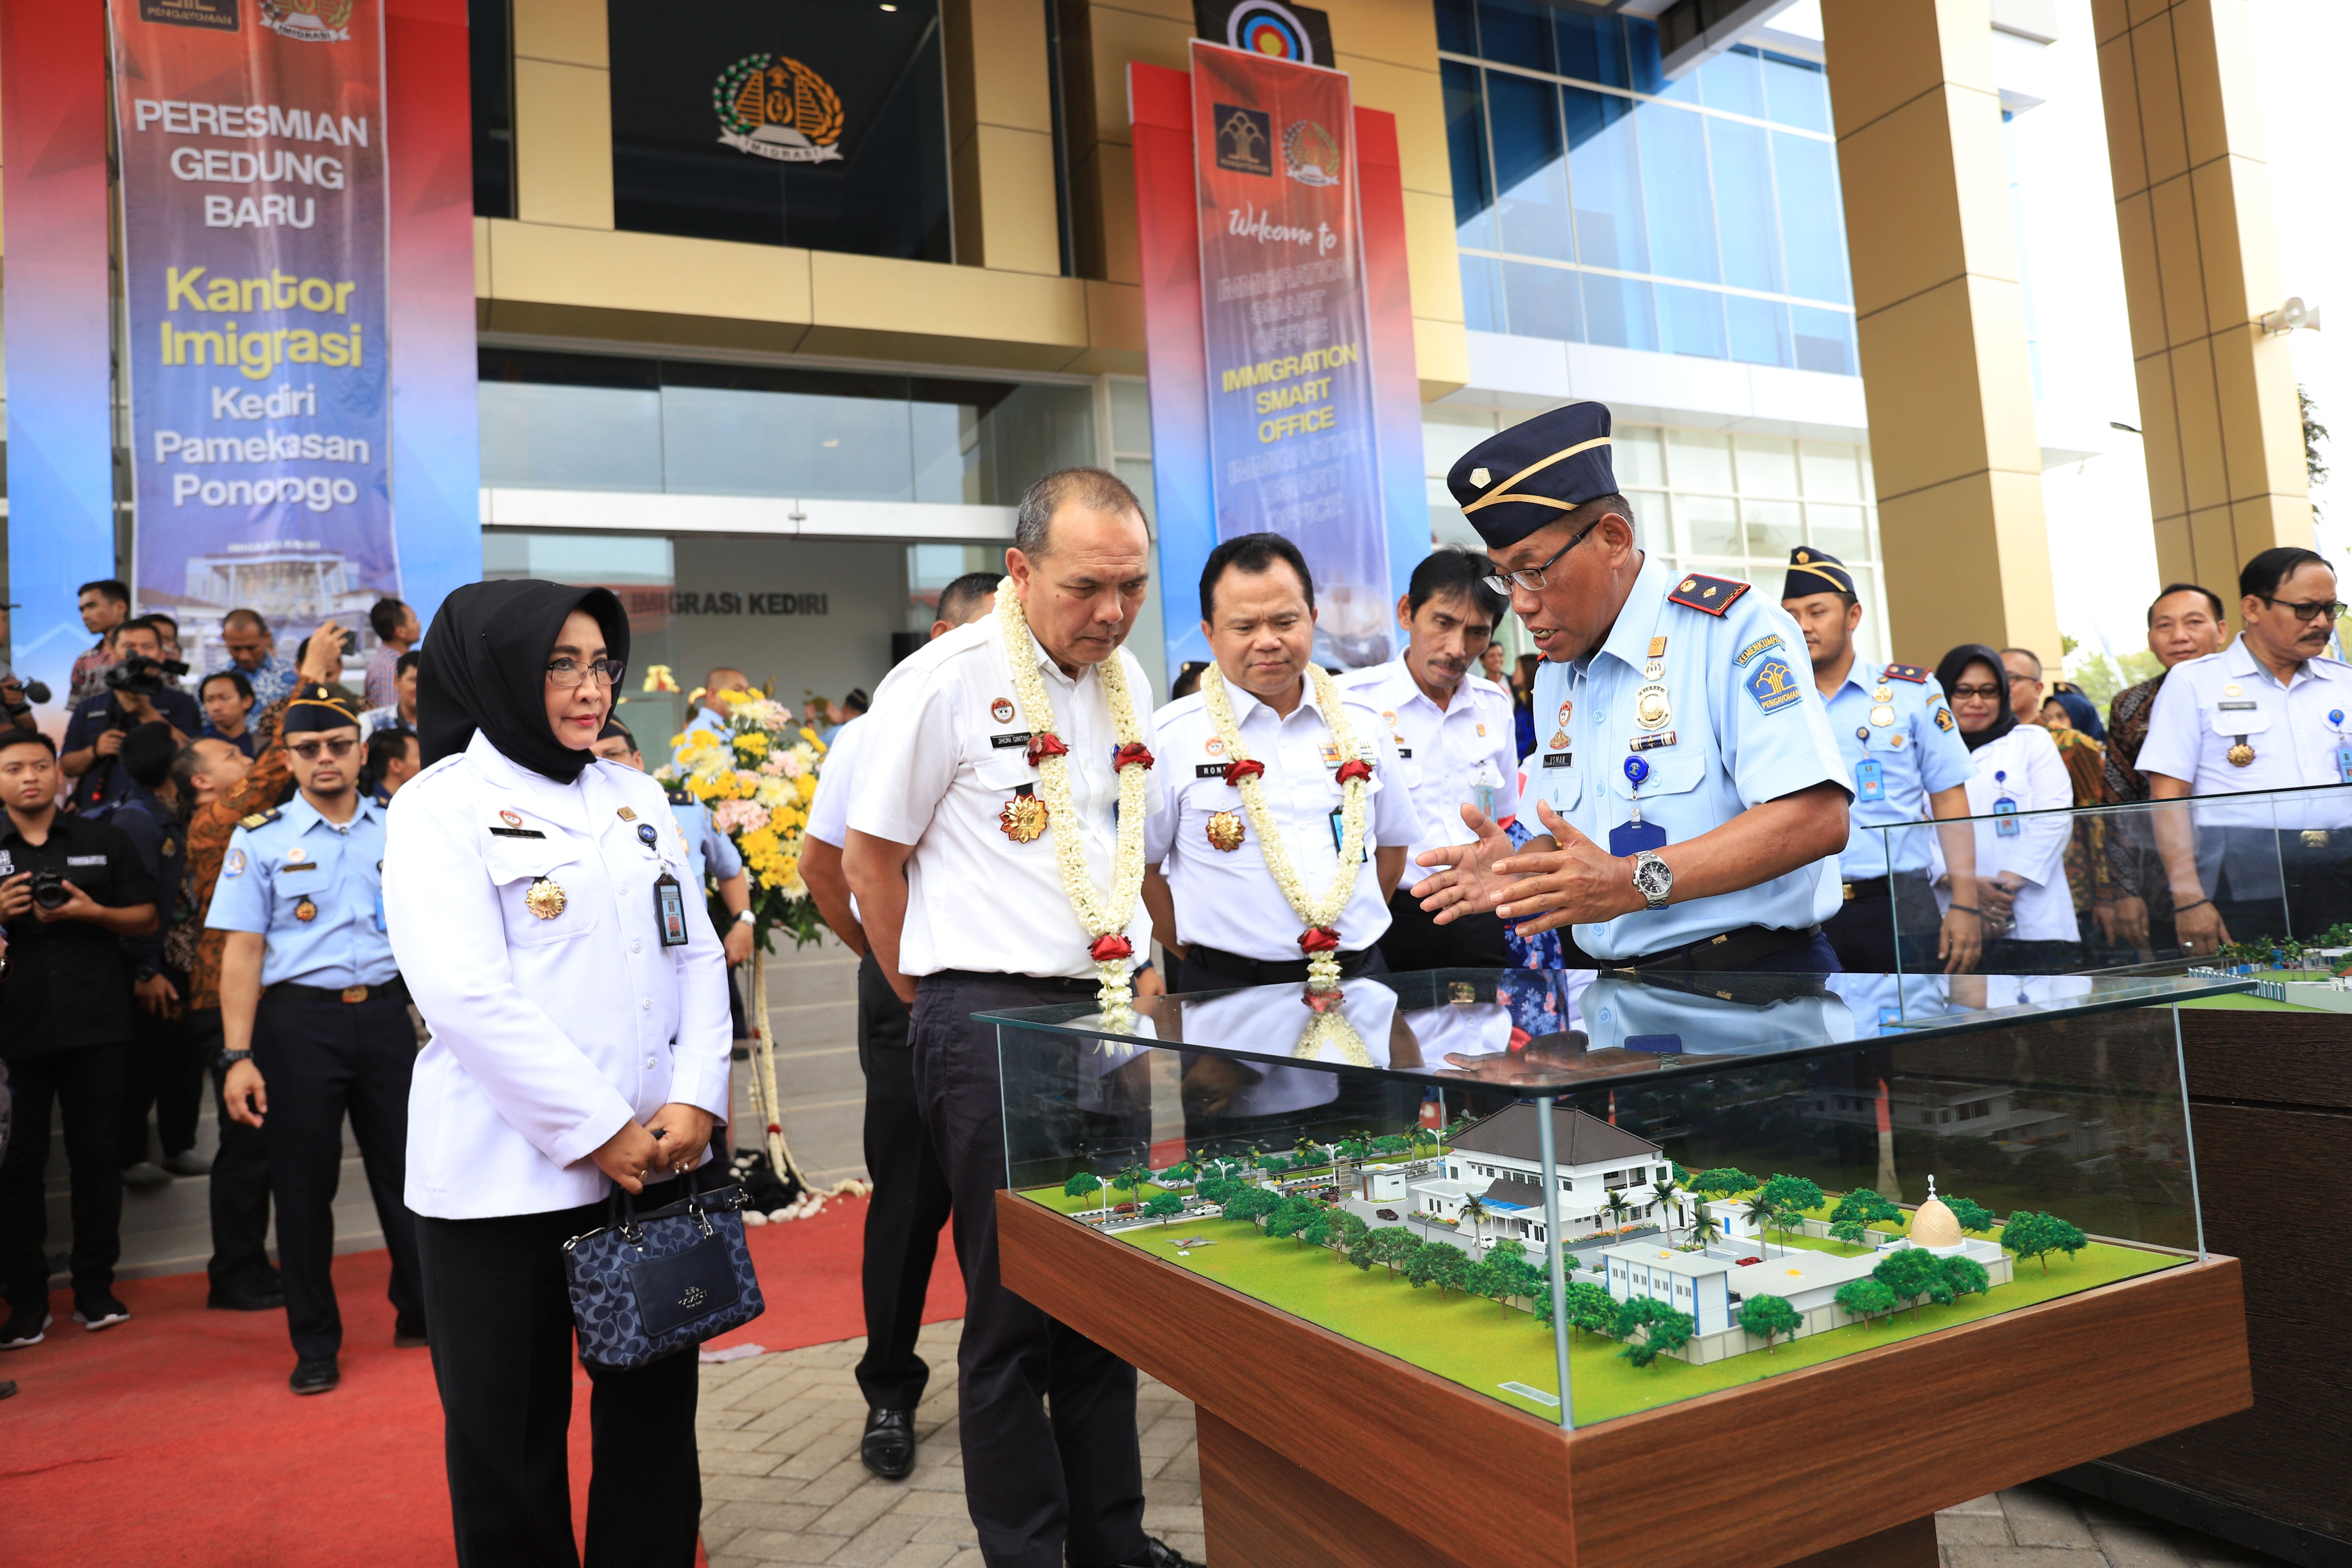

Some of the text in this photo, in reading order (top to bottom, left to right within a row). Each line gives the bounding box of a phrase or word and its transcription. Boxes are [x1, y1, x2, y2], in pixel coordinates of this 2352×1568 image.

[134, 99, 368, 147] PERESMIAN
[170, 148, 345, 190] GEDUNG
[204, 195, 315, 229] BARU
[1228, 201, 1337, 256] Welcome to
[167, 267, 356, 314] Kantor
[161, 321, 362, 380] Imigrasi
[1223, 343, 1358, 392] IMMIGRATION
[212, 383, 316, 421] Kediri
[1256, 377, 1332, 415] SMART
[1259, 406, 1335, 444] OFFICE
[155, 429, 370, 464] Pamekasan
[749, 592, 828, 616] KEDIRI
[1762, 689, 1801, 709] PENGAYOMAN
[1550, 755, 1565, 765] USMAN
